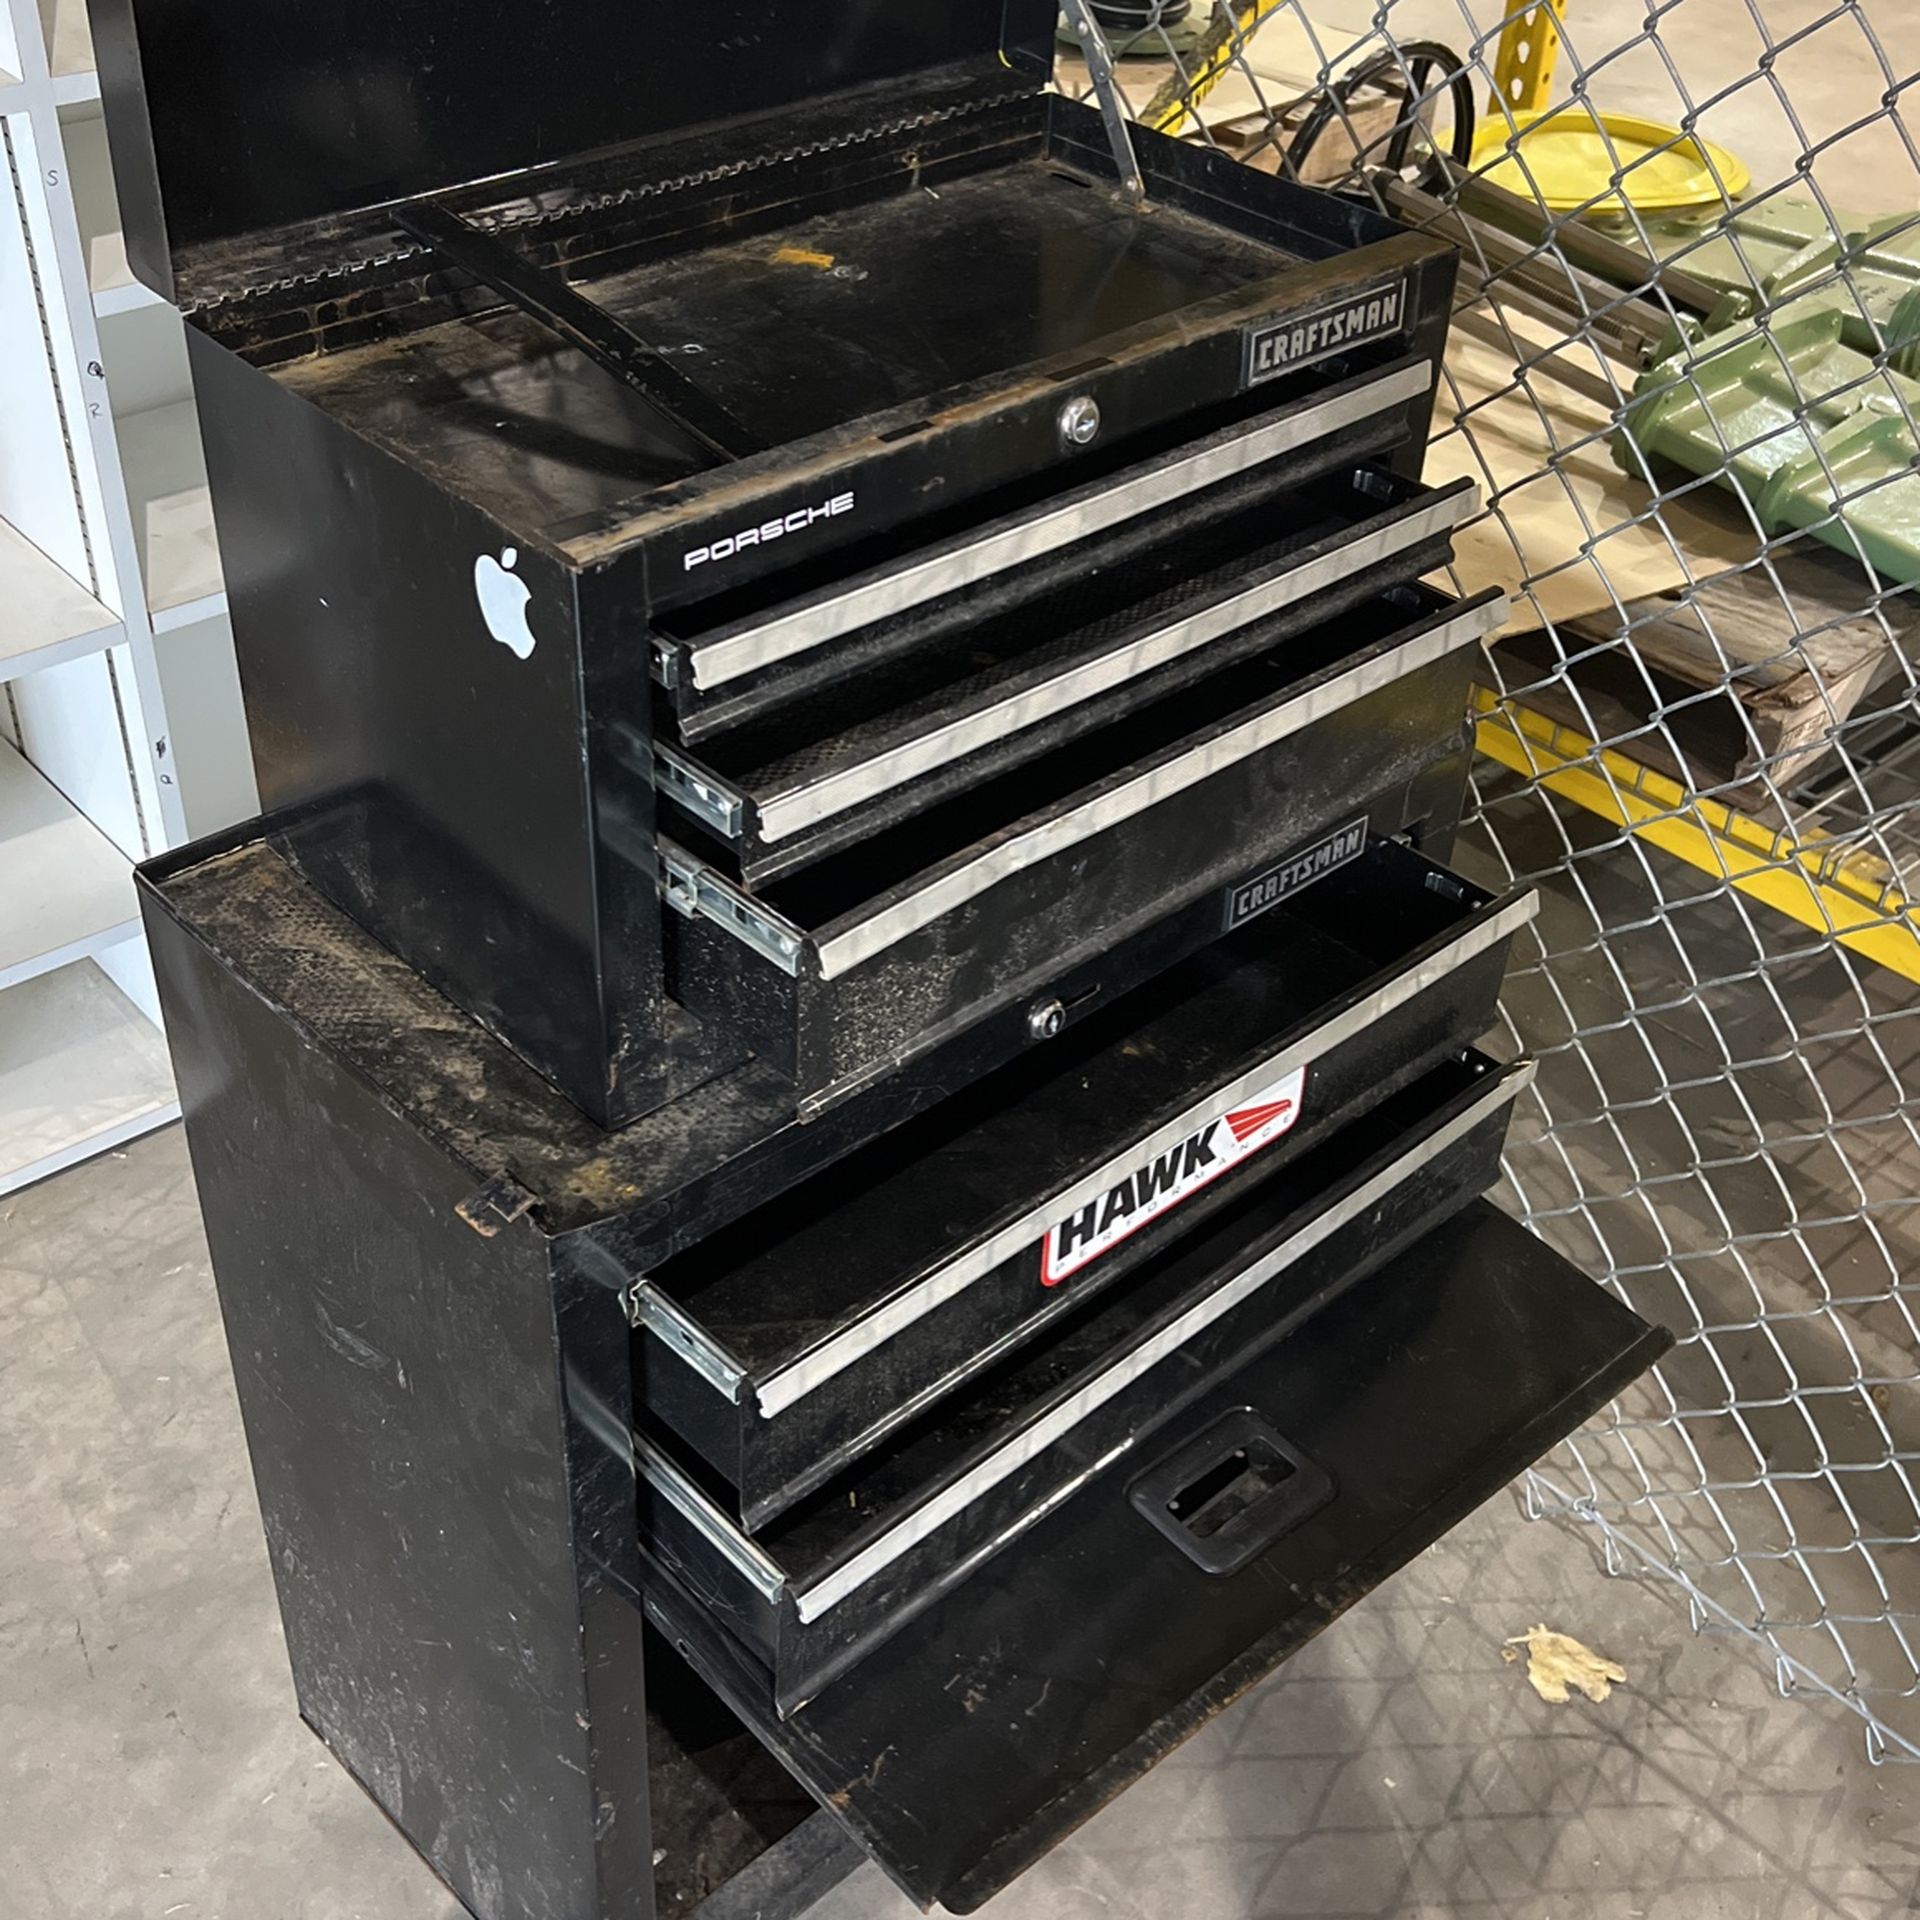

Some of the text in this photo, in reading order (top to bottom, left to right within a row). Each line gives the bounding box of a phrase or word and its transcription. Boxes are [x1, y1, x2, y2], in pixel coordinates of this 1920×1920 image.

[1257, 292, 1398, 371] CRAFTSMAN
[684, 491, 854, 571] PORSCHE
[1237, 828, 1360, 916] CRAFTSMAN
[1055, 1113, 1291, 1273] PERFORMANCE
[1057, 1119, 1222, 1262] HAWK
